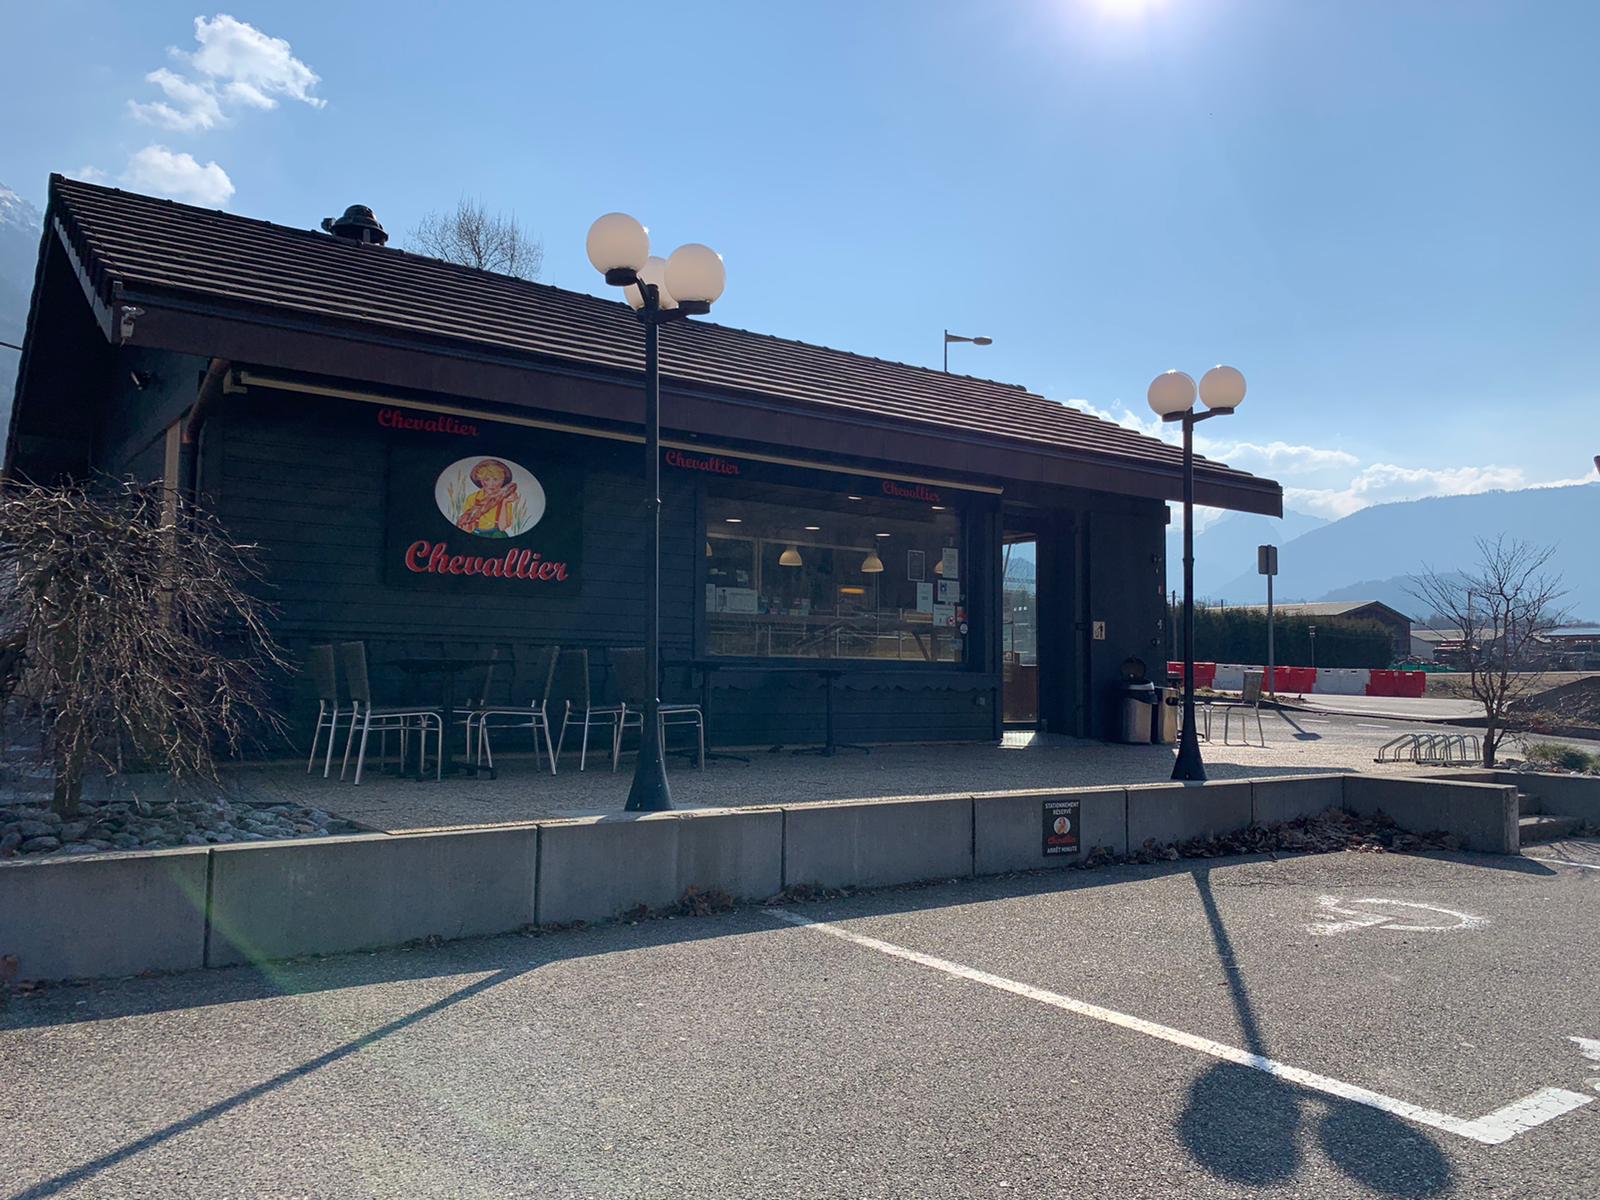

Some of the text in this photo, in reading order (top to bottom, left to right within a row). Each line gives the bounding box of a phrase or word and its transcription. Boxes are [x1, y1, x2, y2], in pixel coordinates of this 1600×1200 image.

[378, 409, 478, 436] Chevallier
[665, 451, 740, 475] Chevallier
[882, 480, 940, 502] Chevallier
[405, 540, 568, 581] Chevallier
